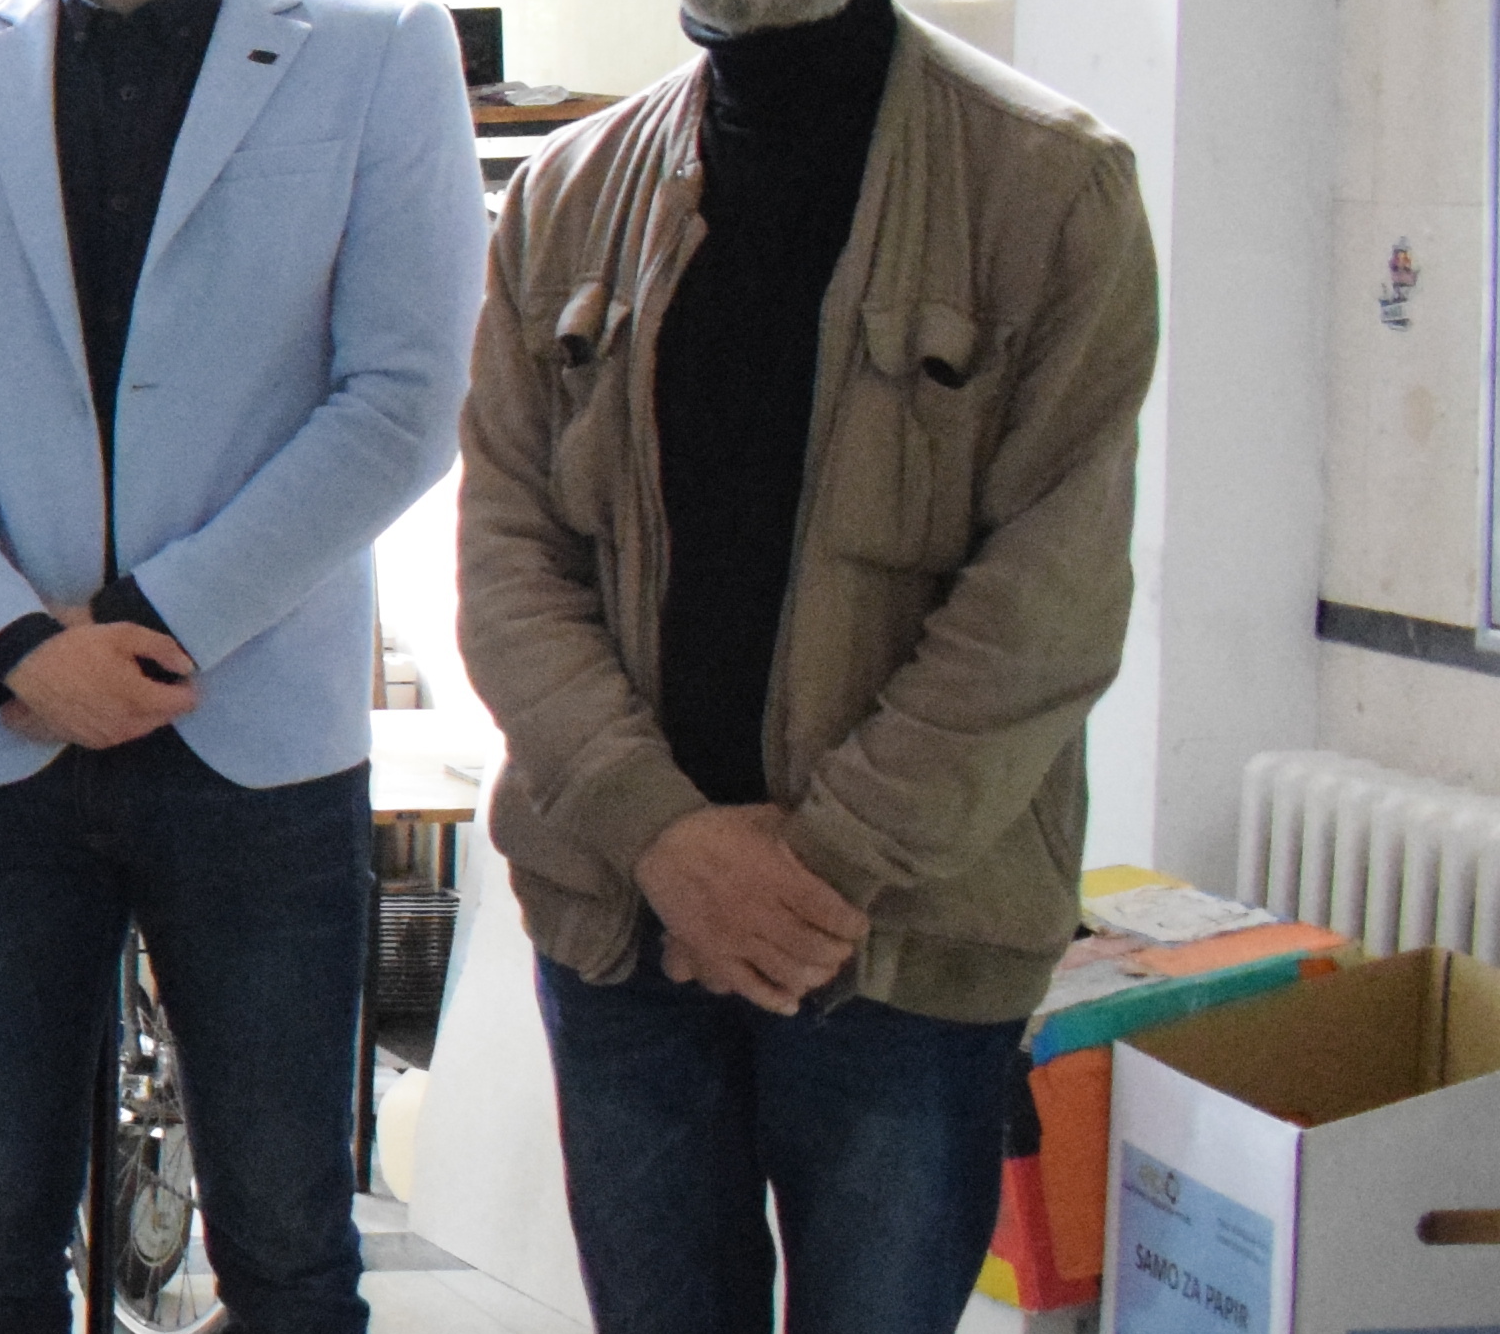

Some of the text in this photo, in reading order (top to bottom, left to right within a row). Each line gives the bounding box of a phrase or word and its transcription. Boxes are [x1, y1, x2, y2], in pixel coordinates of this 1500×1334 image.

[1134, 1242, 1250, 1330] SAMO ZA PAPIR
